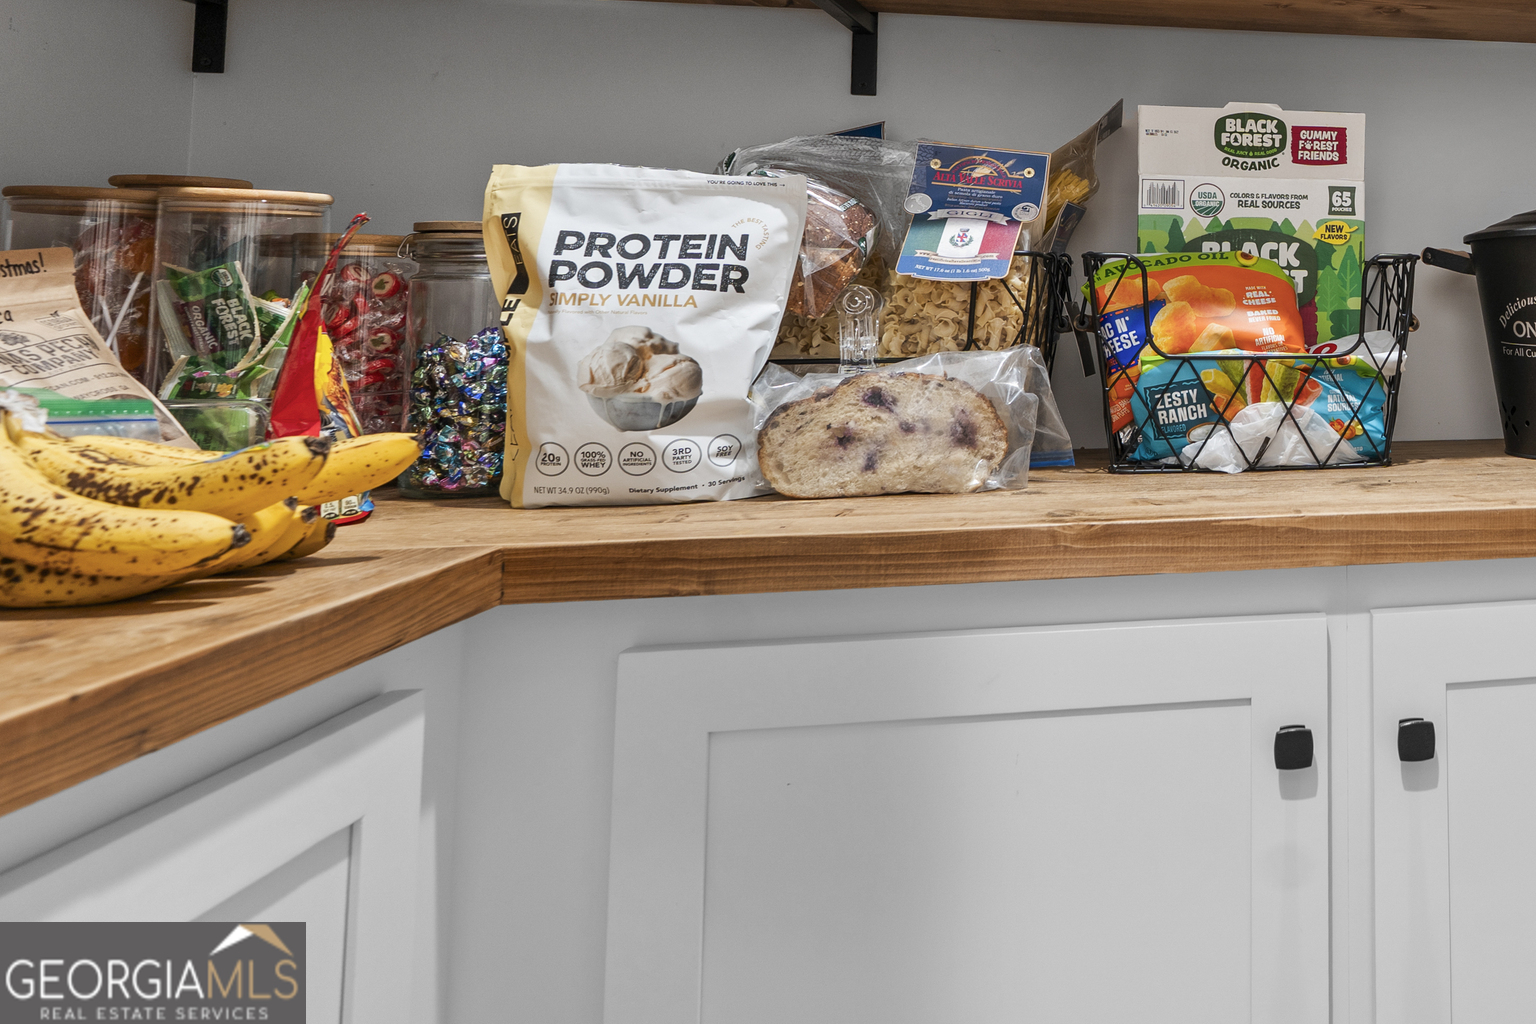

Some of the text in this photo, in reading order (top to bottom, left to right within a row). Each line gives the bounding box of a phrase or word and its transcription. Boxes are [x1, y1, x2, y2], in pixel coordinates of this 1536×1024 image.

[1226, 118, 1278, 134] BLACK
[1221, 133, 1282, 147] FOREST
[1300, 130, 1338, 141] GUMMY
[1298, 151, 1339, 161] FRIENDS
[1222, 156, 1280, 171] ORGANIC
[933, 171, 957, 183] ALTA
[987, 175, 1022, 189] SCRIVIA
[1198, 191, 1217, 199] USDA
[1331, 191, 1351, 207] 65
[1238, 200, 1300, 210] REAL SOURCES
[946, 209, 993, 220] GIGLI
[1325, 225, 1344, 233] NEW
[553, 230, 749, 261] PROTEIN
[1104, 250, 1229, 278] AVOCADO OIL
[548, 259, 749, 293] POWDER
[549, 291, 698, 308] SIMPLY VANILLA
[226, 297, 254, 341] BLACK
[1503, 347, 1513, 356] For
[1514, 347, 1524, 356] All
[10, 348, 100, 375] COMPANY
[1155, 389, 1198, 410] ZESTY
[1158, 399, 1208, 424] RANCH
[581, 451, 606, 459] 100%
[672, 447, 692, 456] 3RD
[716, 445, 733, 453] SOY
[541, 452, 561, 463] 20g
[534, 486, 610, 496] NET WT 34.9 OZ (990g)
[629, 487, 654, 495] Dietary
[655, 484, 698, 493] Supplement
[718, 476, 746, 486] Servings
